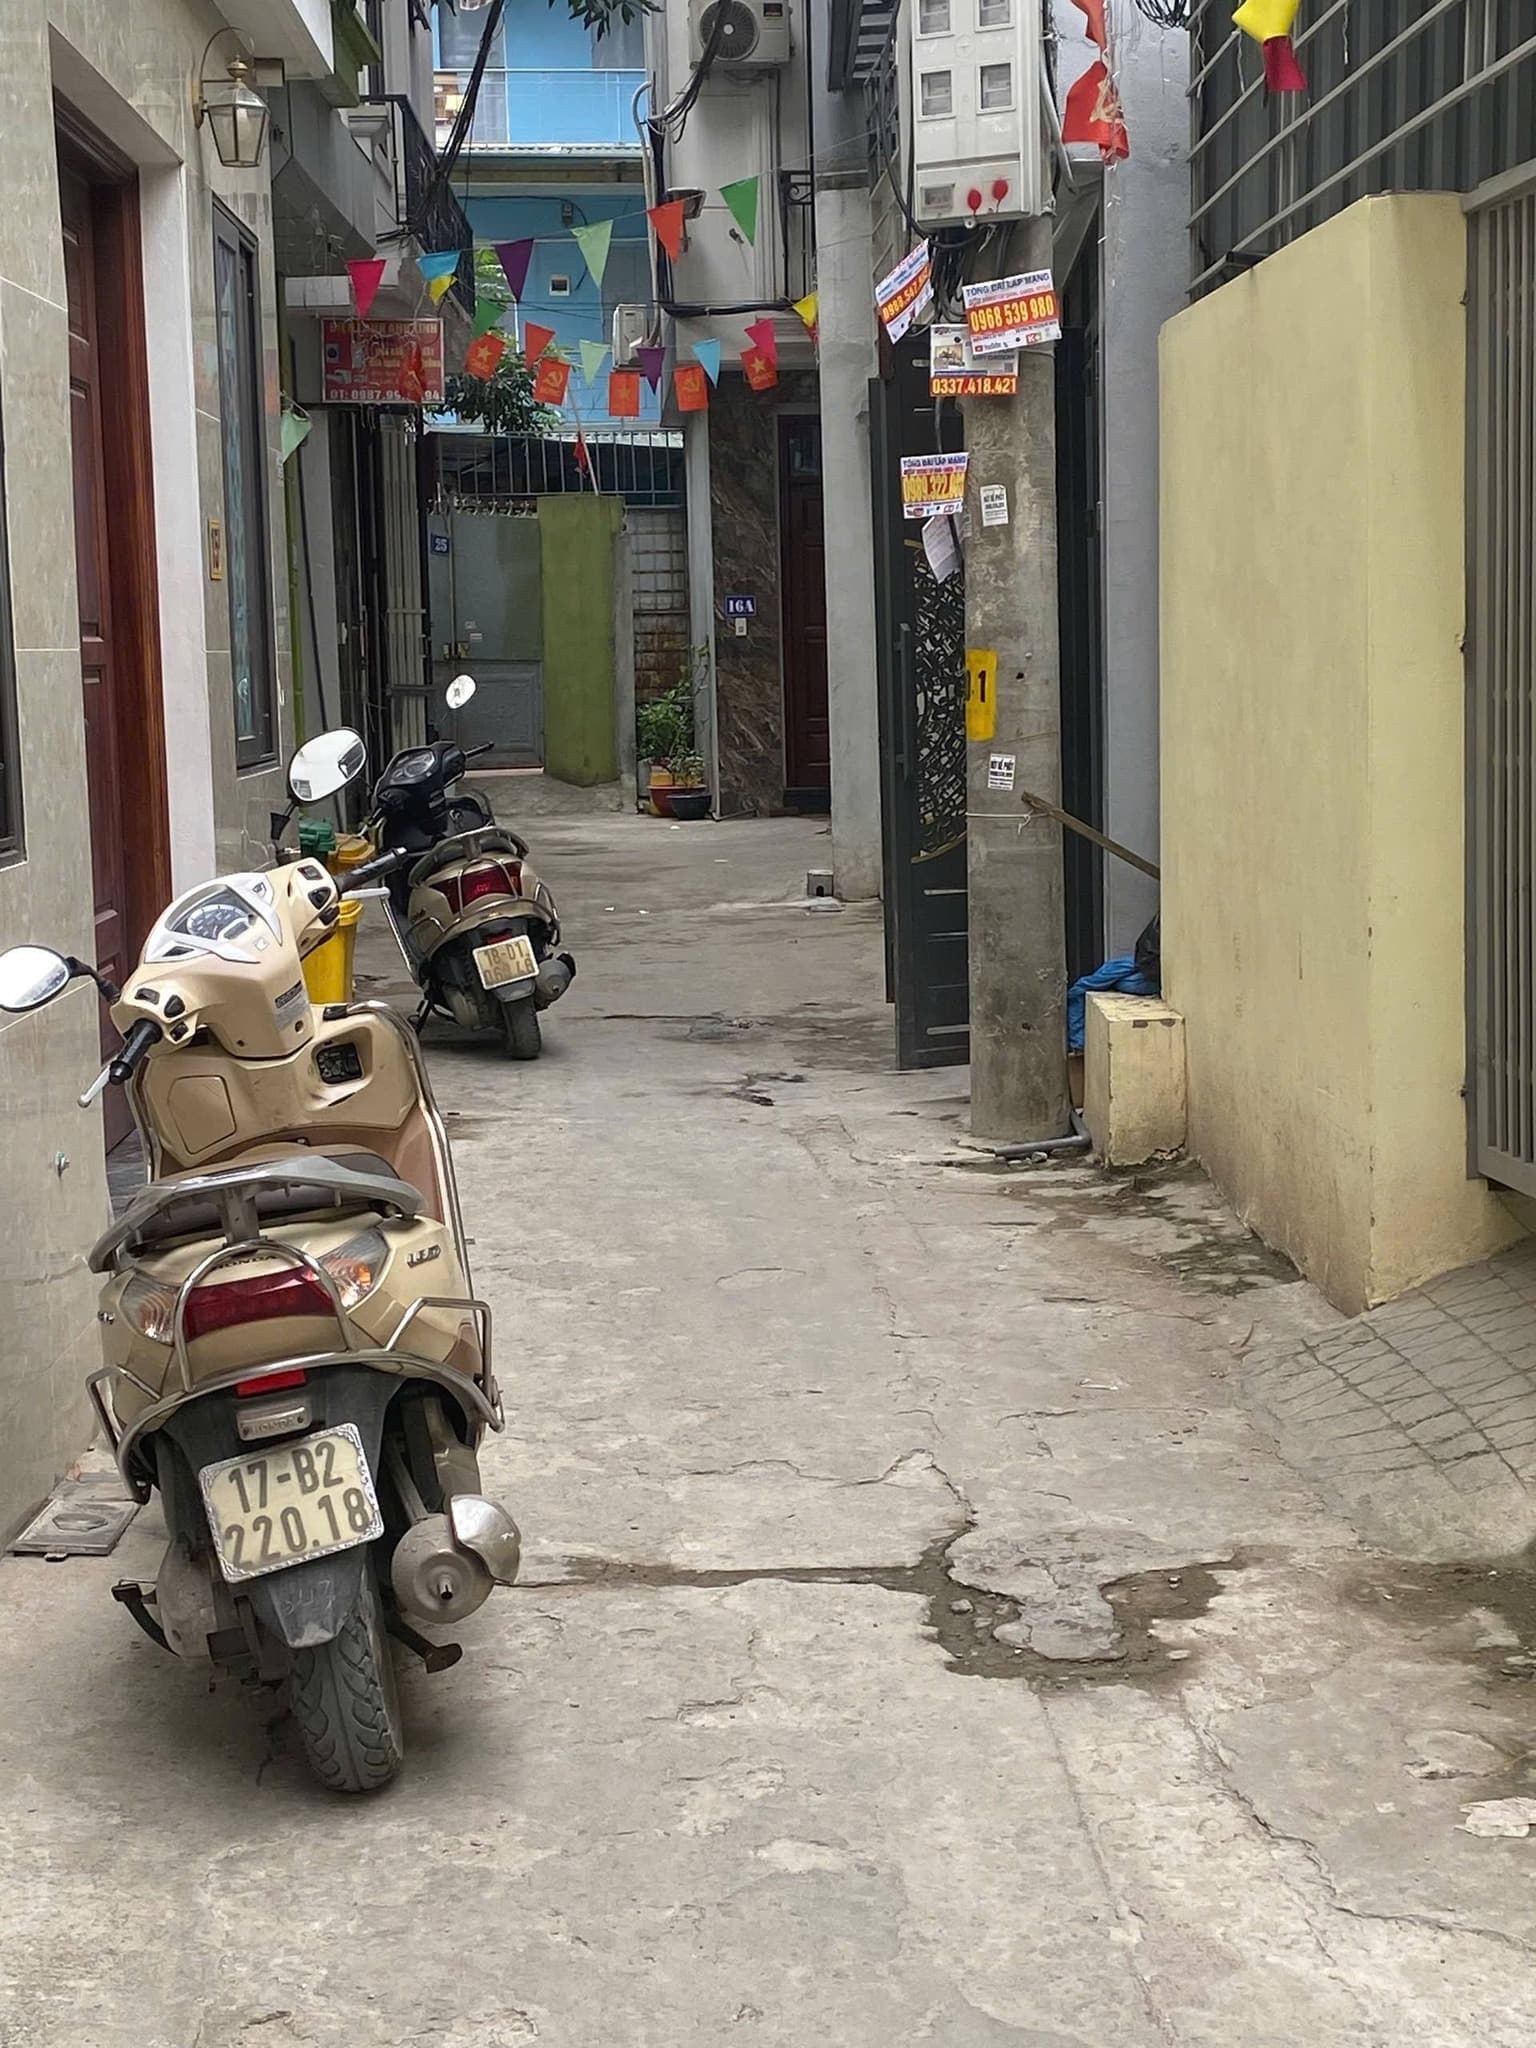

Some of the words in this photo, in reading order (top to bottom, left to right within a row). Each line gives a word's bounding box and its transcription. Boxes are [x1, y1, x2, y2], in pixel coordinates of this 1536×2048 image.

[970, 305, 1003, 333] 0968
[1003, 300, 1028, 326] 539
[1029, 294, 1055, 320] 980
[932, 377, 1017, 394] 0337.418.421
[434, 537, 448, 553] 25
[728, 599, 754, 613] 16A
[228, 1440, 344, 1514] 17-B2
[224, 1487, 371, 1570] 220.18
